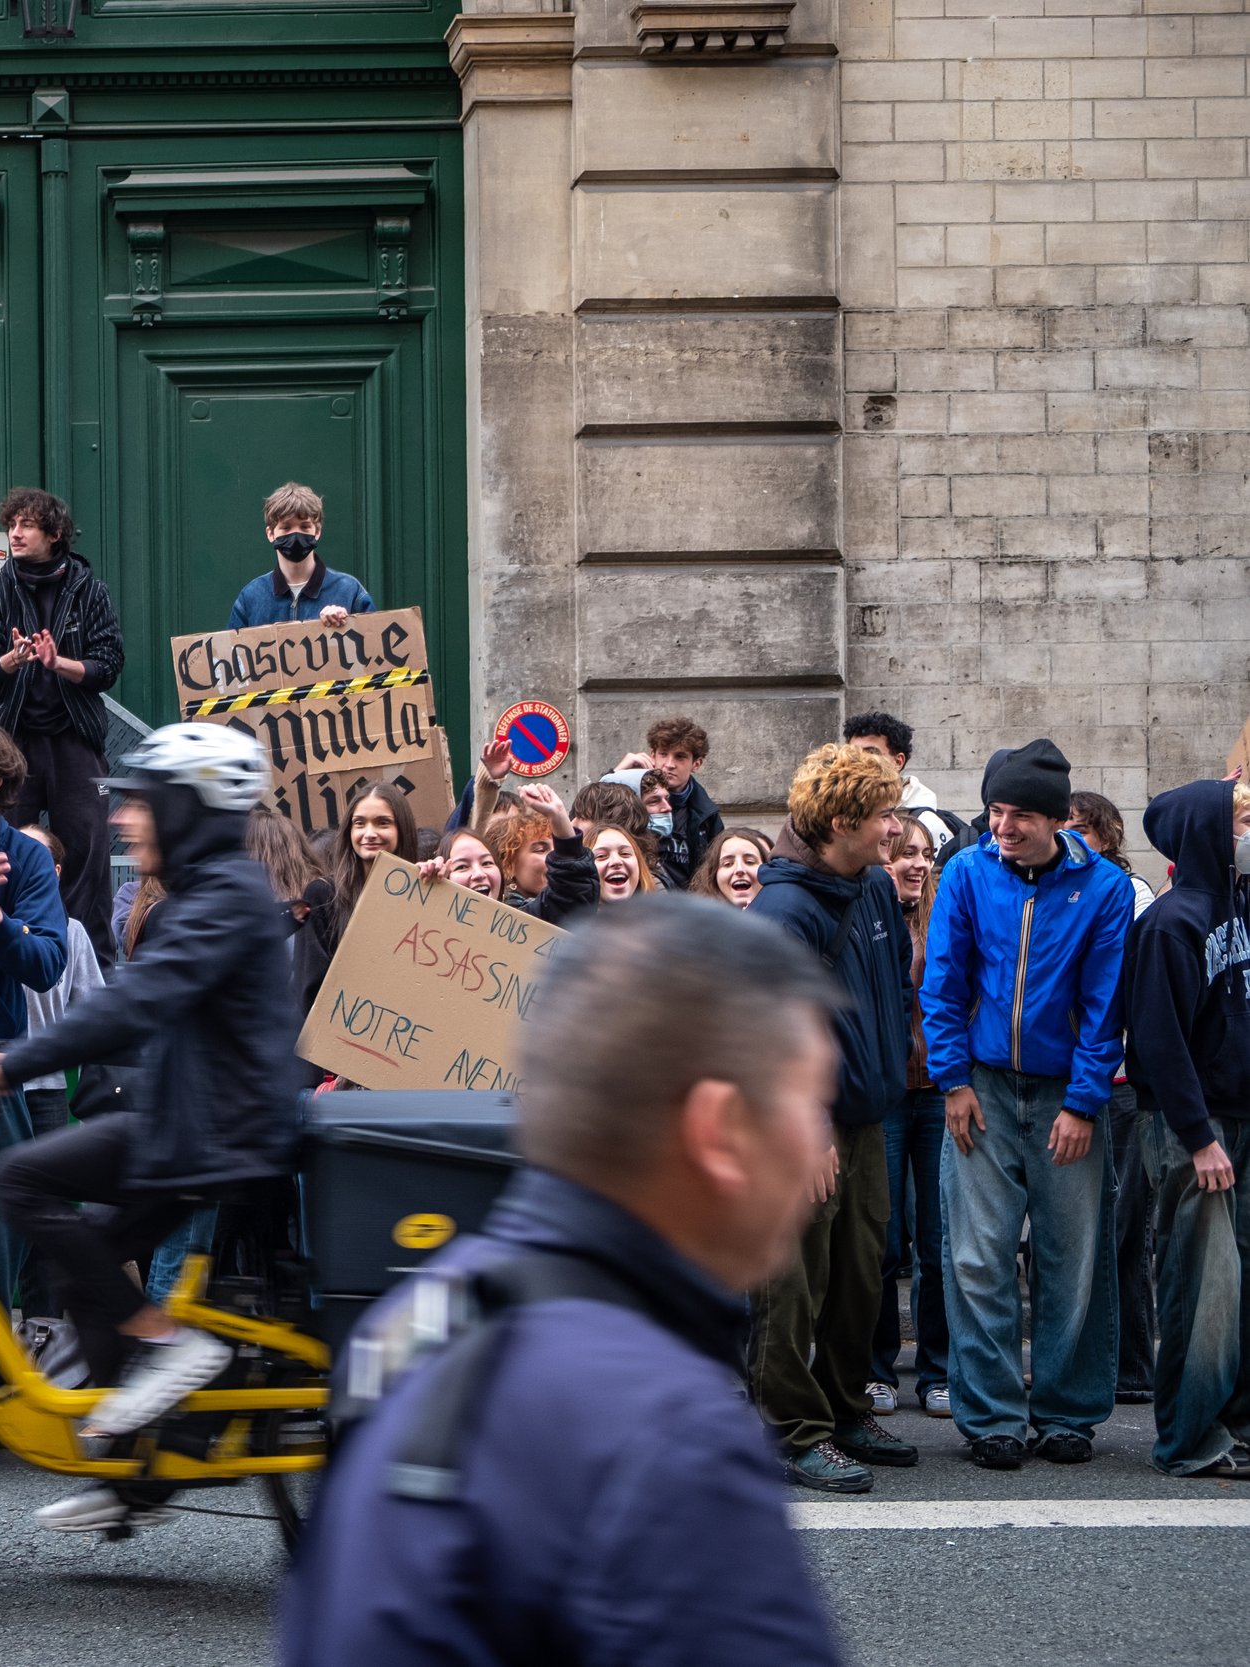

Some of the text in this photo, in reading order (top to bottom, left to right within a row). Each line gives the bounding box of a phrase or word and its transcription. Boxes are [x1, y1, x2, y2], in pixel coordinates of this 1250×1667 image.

[523, 703, 533, 712] DE
[534, 703, 567, 742] STATIONNER
[519, 764, 530, 773] DE
[531, 750, 563, 774] SECOURS
[384, 867, 434, 906] ON
[447, 892, 479, 927] NE
[489, 909, 529, 944] VOUS
[330, 989, 433, 1060] NOTRE
